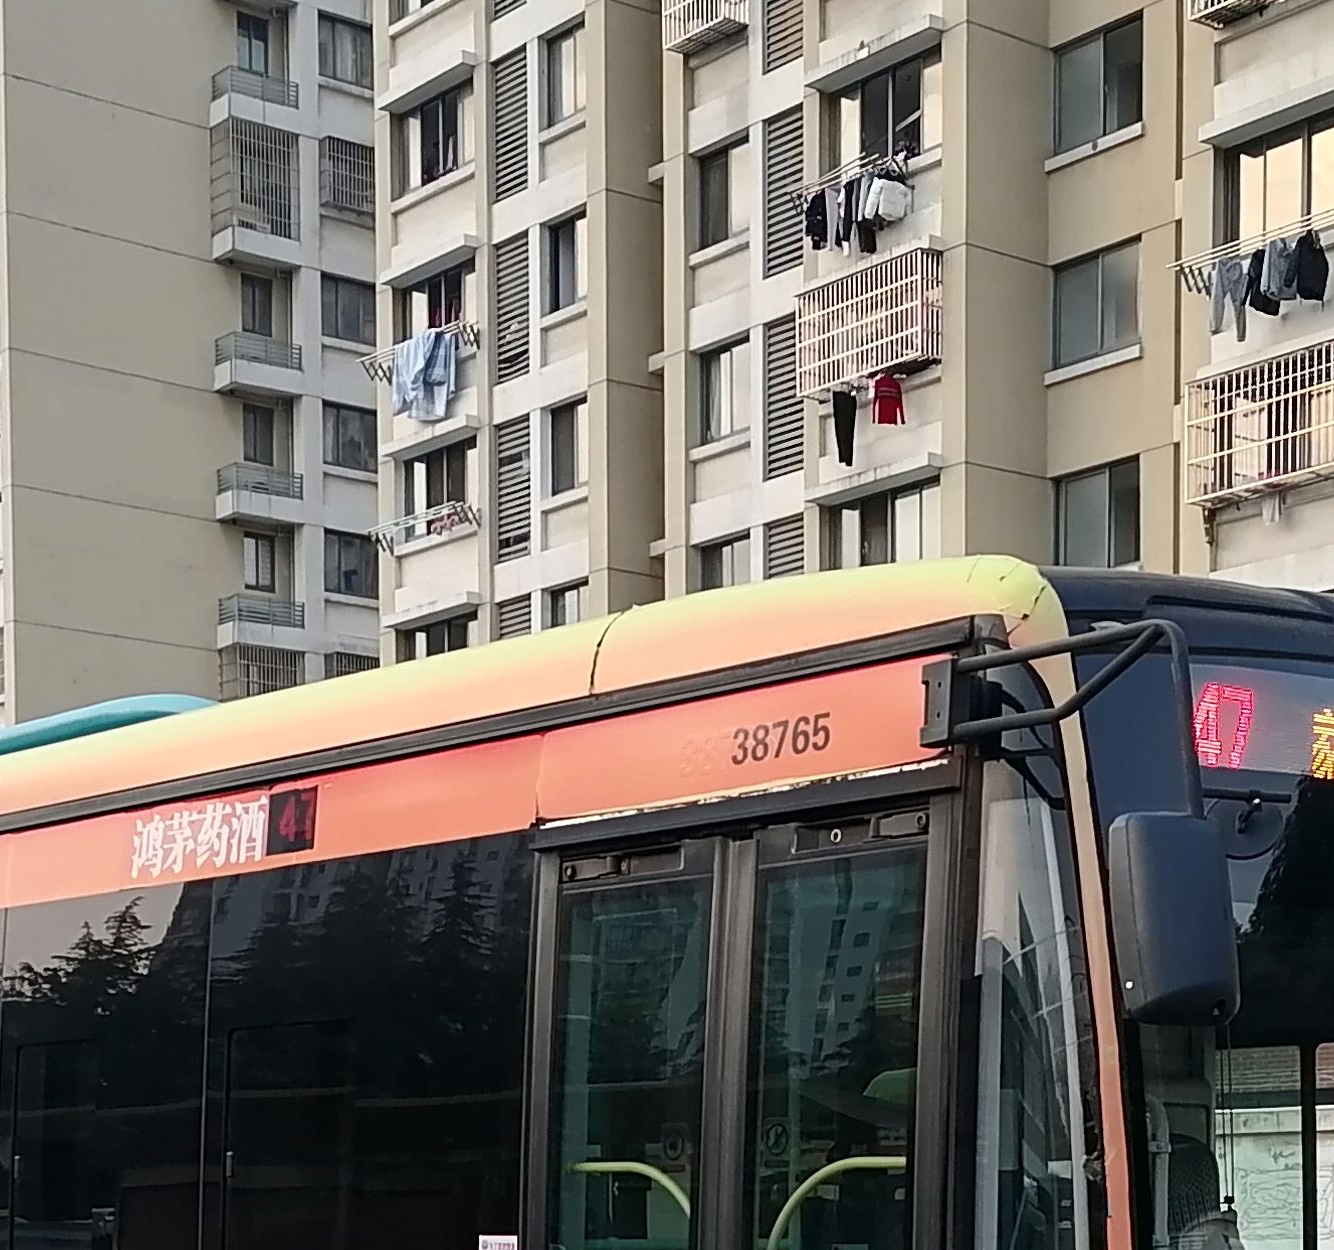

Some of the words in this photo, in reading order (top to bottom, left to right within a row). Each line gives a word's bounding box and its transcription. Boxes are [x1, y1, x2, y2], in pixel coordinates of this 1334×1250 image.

[731, 712, 831, 766] 38765
[1193, 682, 1254, 769] 47
[131, 795, 269, 879] 鸿茅药酒
[279, 791, 316, 842] 47
